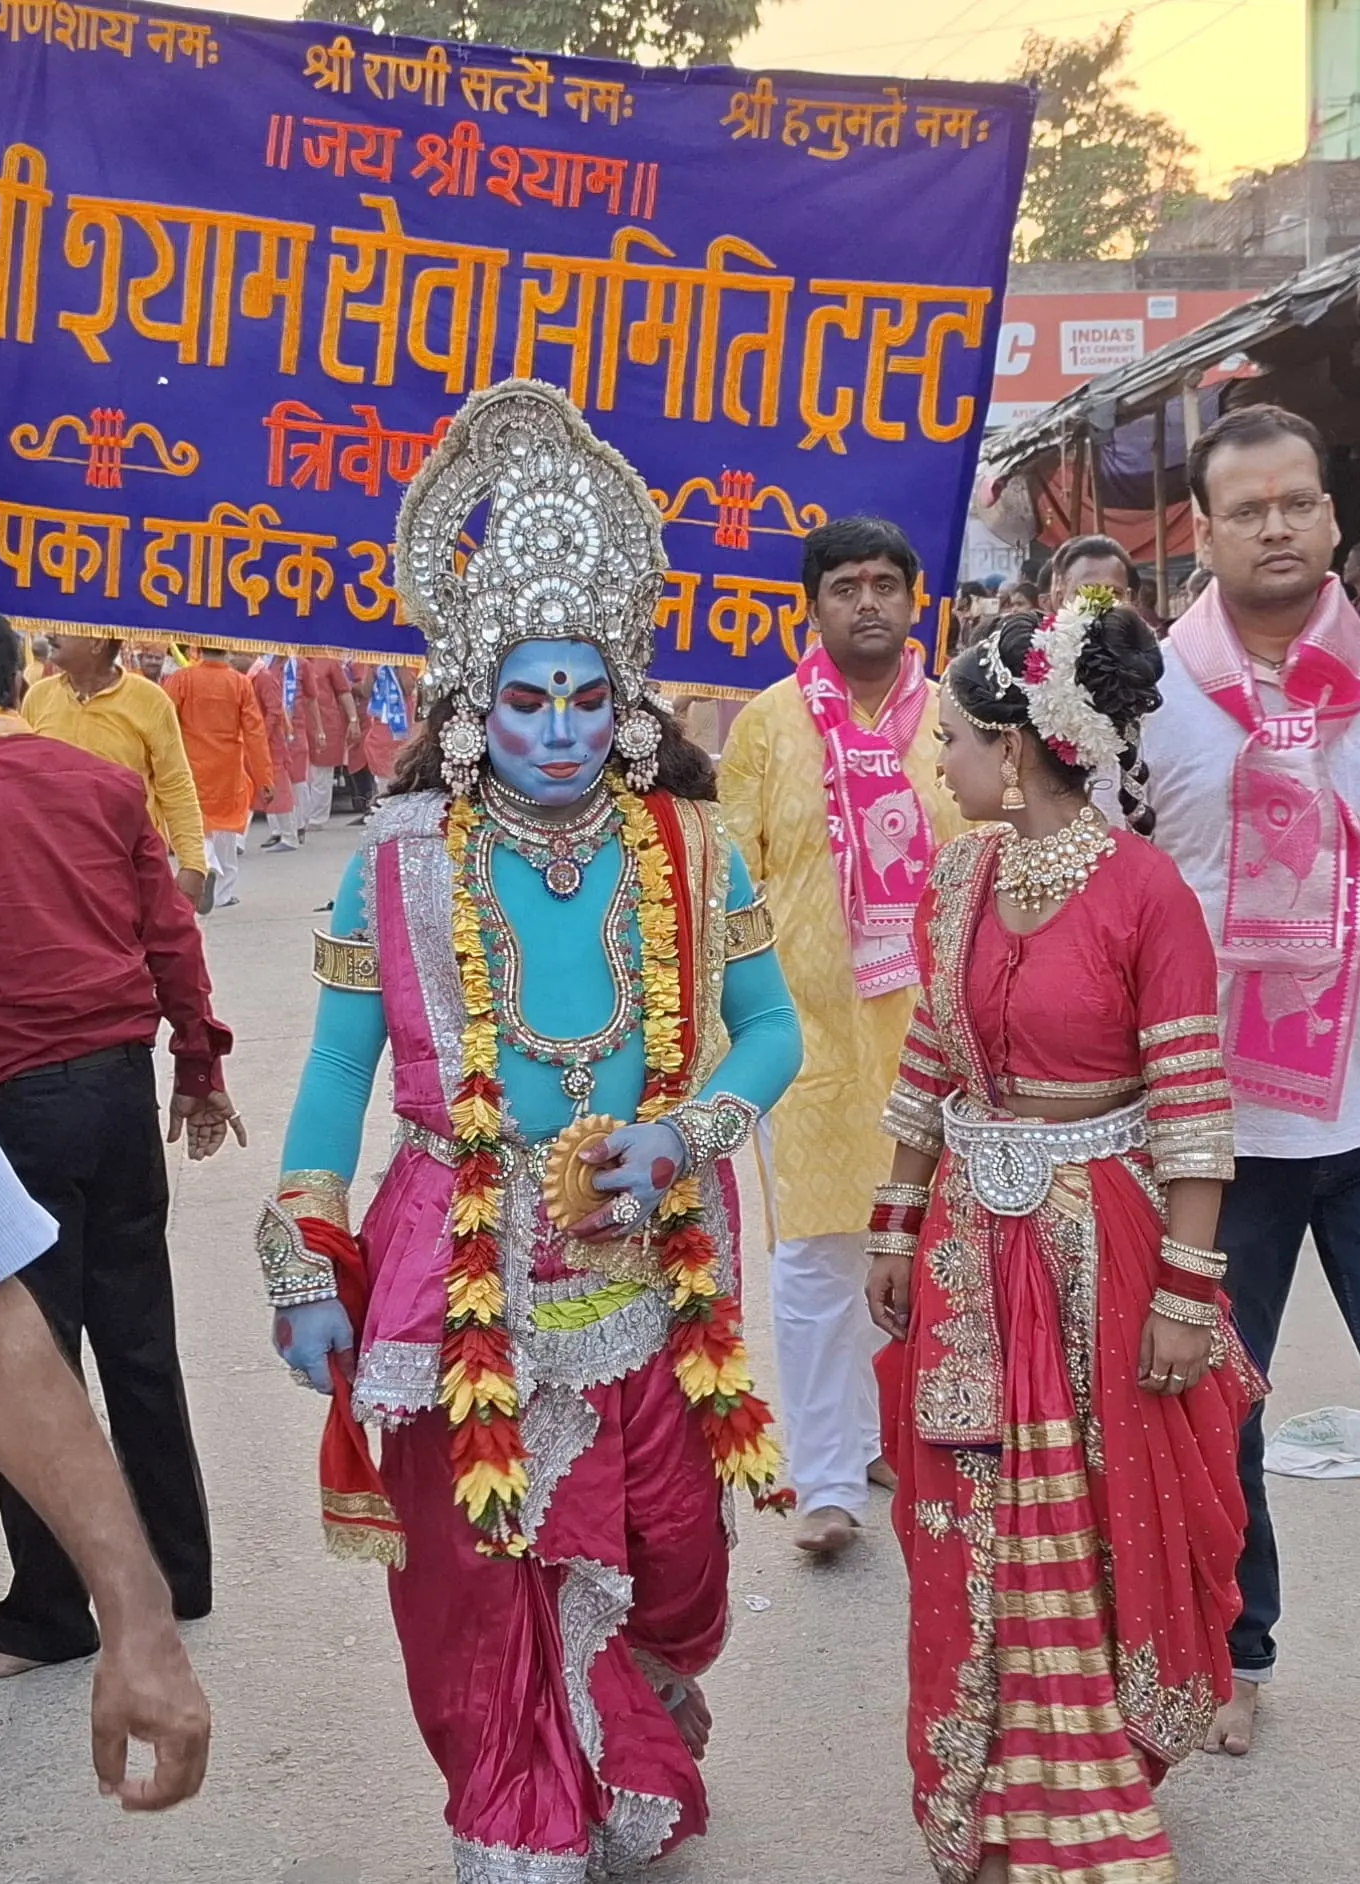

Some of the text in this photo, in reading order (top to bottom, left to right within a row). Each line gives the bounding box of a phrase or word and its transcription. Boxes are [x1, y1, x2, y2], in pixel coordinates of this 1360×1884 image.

[147, 18, 220, 69] नमः
[303, 36, 355, 93] श्री
[364, 45, 452, 107] राणी
[563, 77, 635, 126] नमः
[411, 120, 485, 197] श्री
[720, 77, 990, 161] श्री हनुमते नमः
[58, 193, 316, 376] श्याम
[319, 192, 510, 396] सेवा
[513, 226, 795, 428] समिति
[798, 278, 993, 455] ट्रस्ट
[1072, 328, 1136, 342] INDIA'S
[139, 502, 337, 618] हार्दिक
